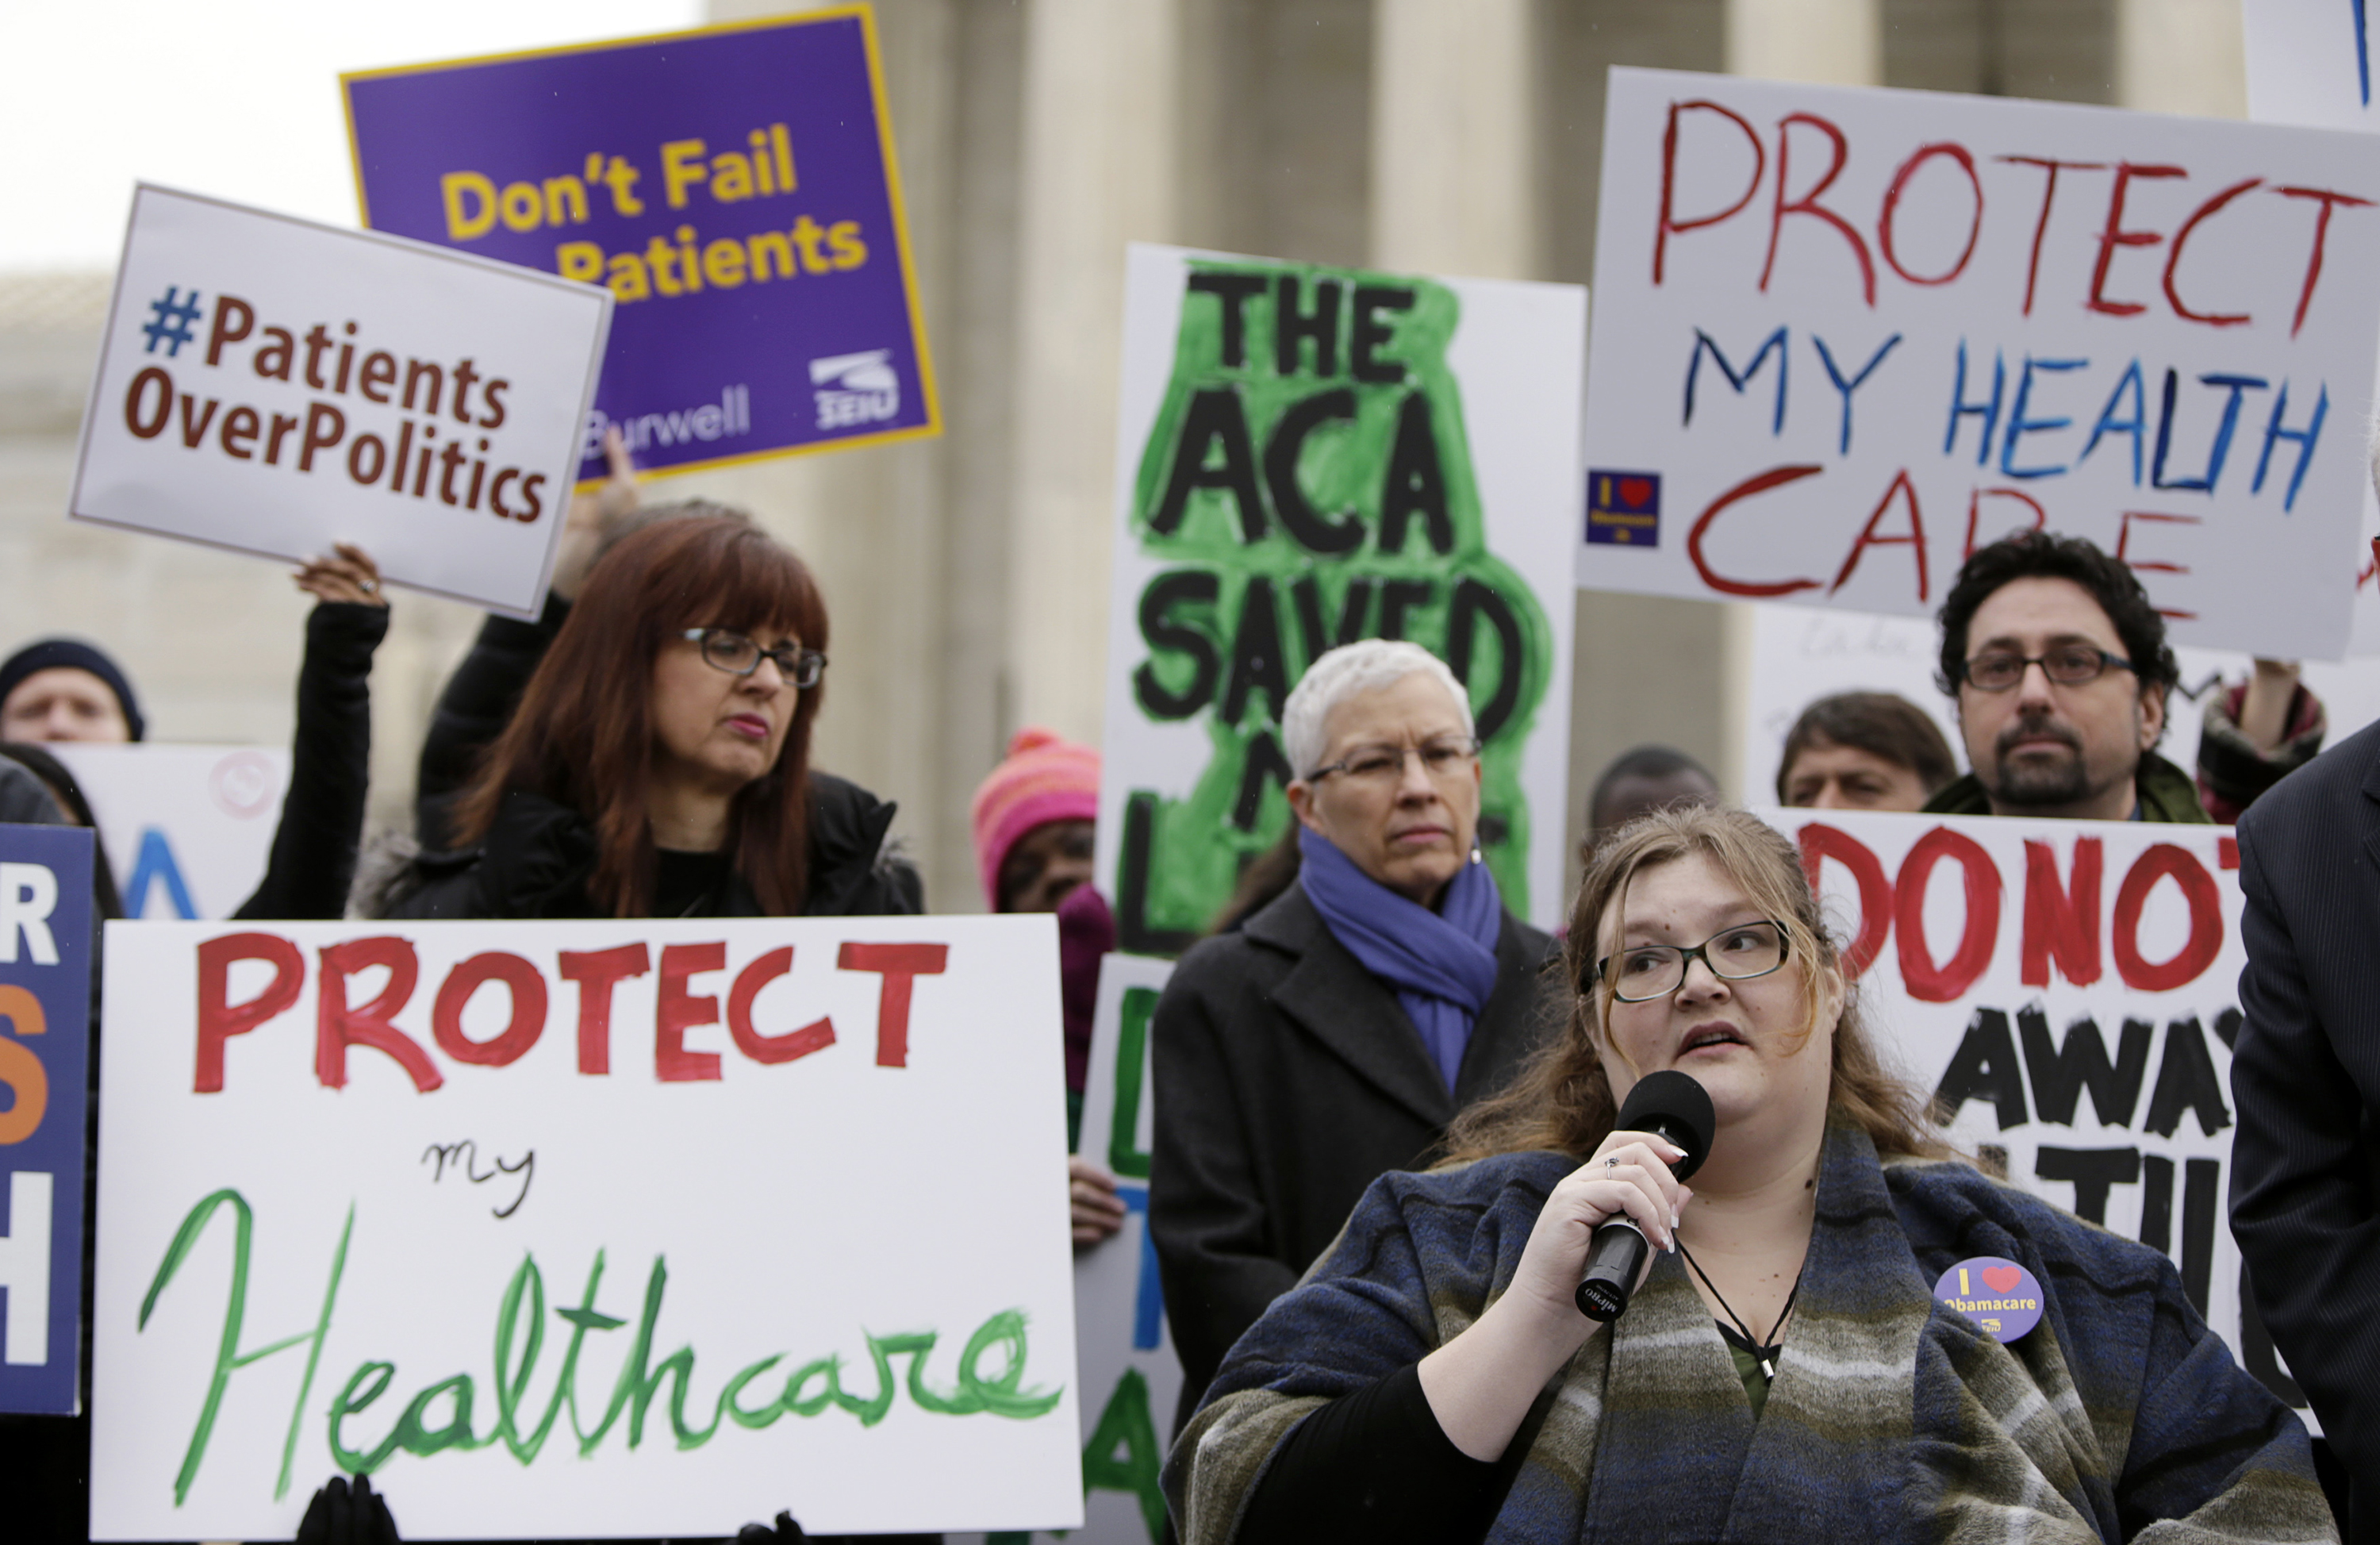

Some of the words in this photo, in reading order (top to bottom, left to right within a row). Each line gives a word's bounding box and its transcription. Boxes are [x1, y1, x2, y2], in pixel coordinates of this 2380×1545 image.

[441, 152, 643, 240] Don't
[661, 123, 797, 209] Fail
[1653, 98, 2378, 340] PROTECT
[557, 216, 867, 302] Patients
[1186, 271, 1415, 383] THE
[141, 285, 510, 430] #Patients
[815, 390, 900, 431] SEIU
[1683, 325, 1902, 456] MY
[1943, 336, 2329, 512] HEALTH
[124, 367, 546, 524] OverPolitics
[1148, 389, 1453, 555] ACA
[1797, 822, 2003, 1003] DO
[2021, 835, 2240, 993] NO
[192, 932, 950, 1093] PROTECT
[1926, 997, 2246, 1140] AWA
[422, 1140, 536, 1219] my
[139, 1188, 1064, 1508] Healthcare
[1959, 1268, 1970, 1295] I
